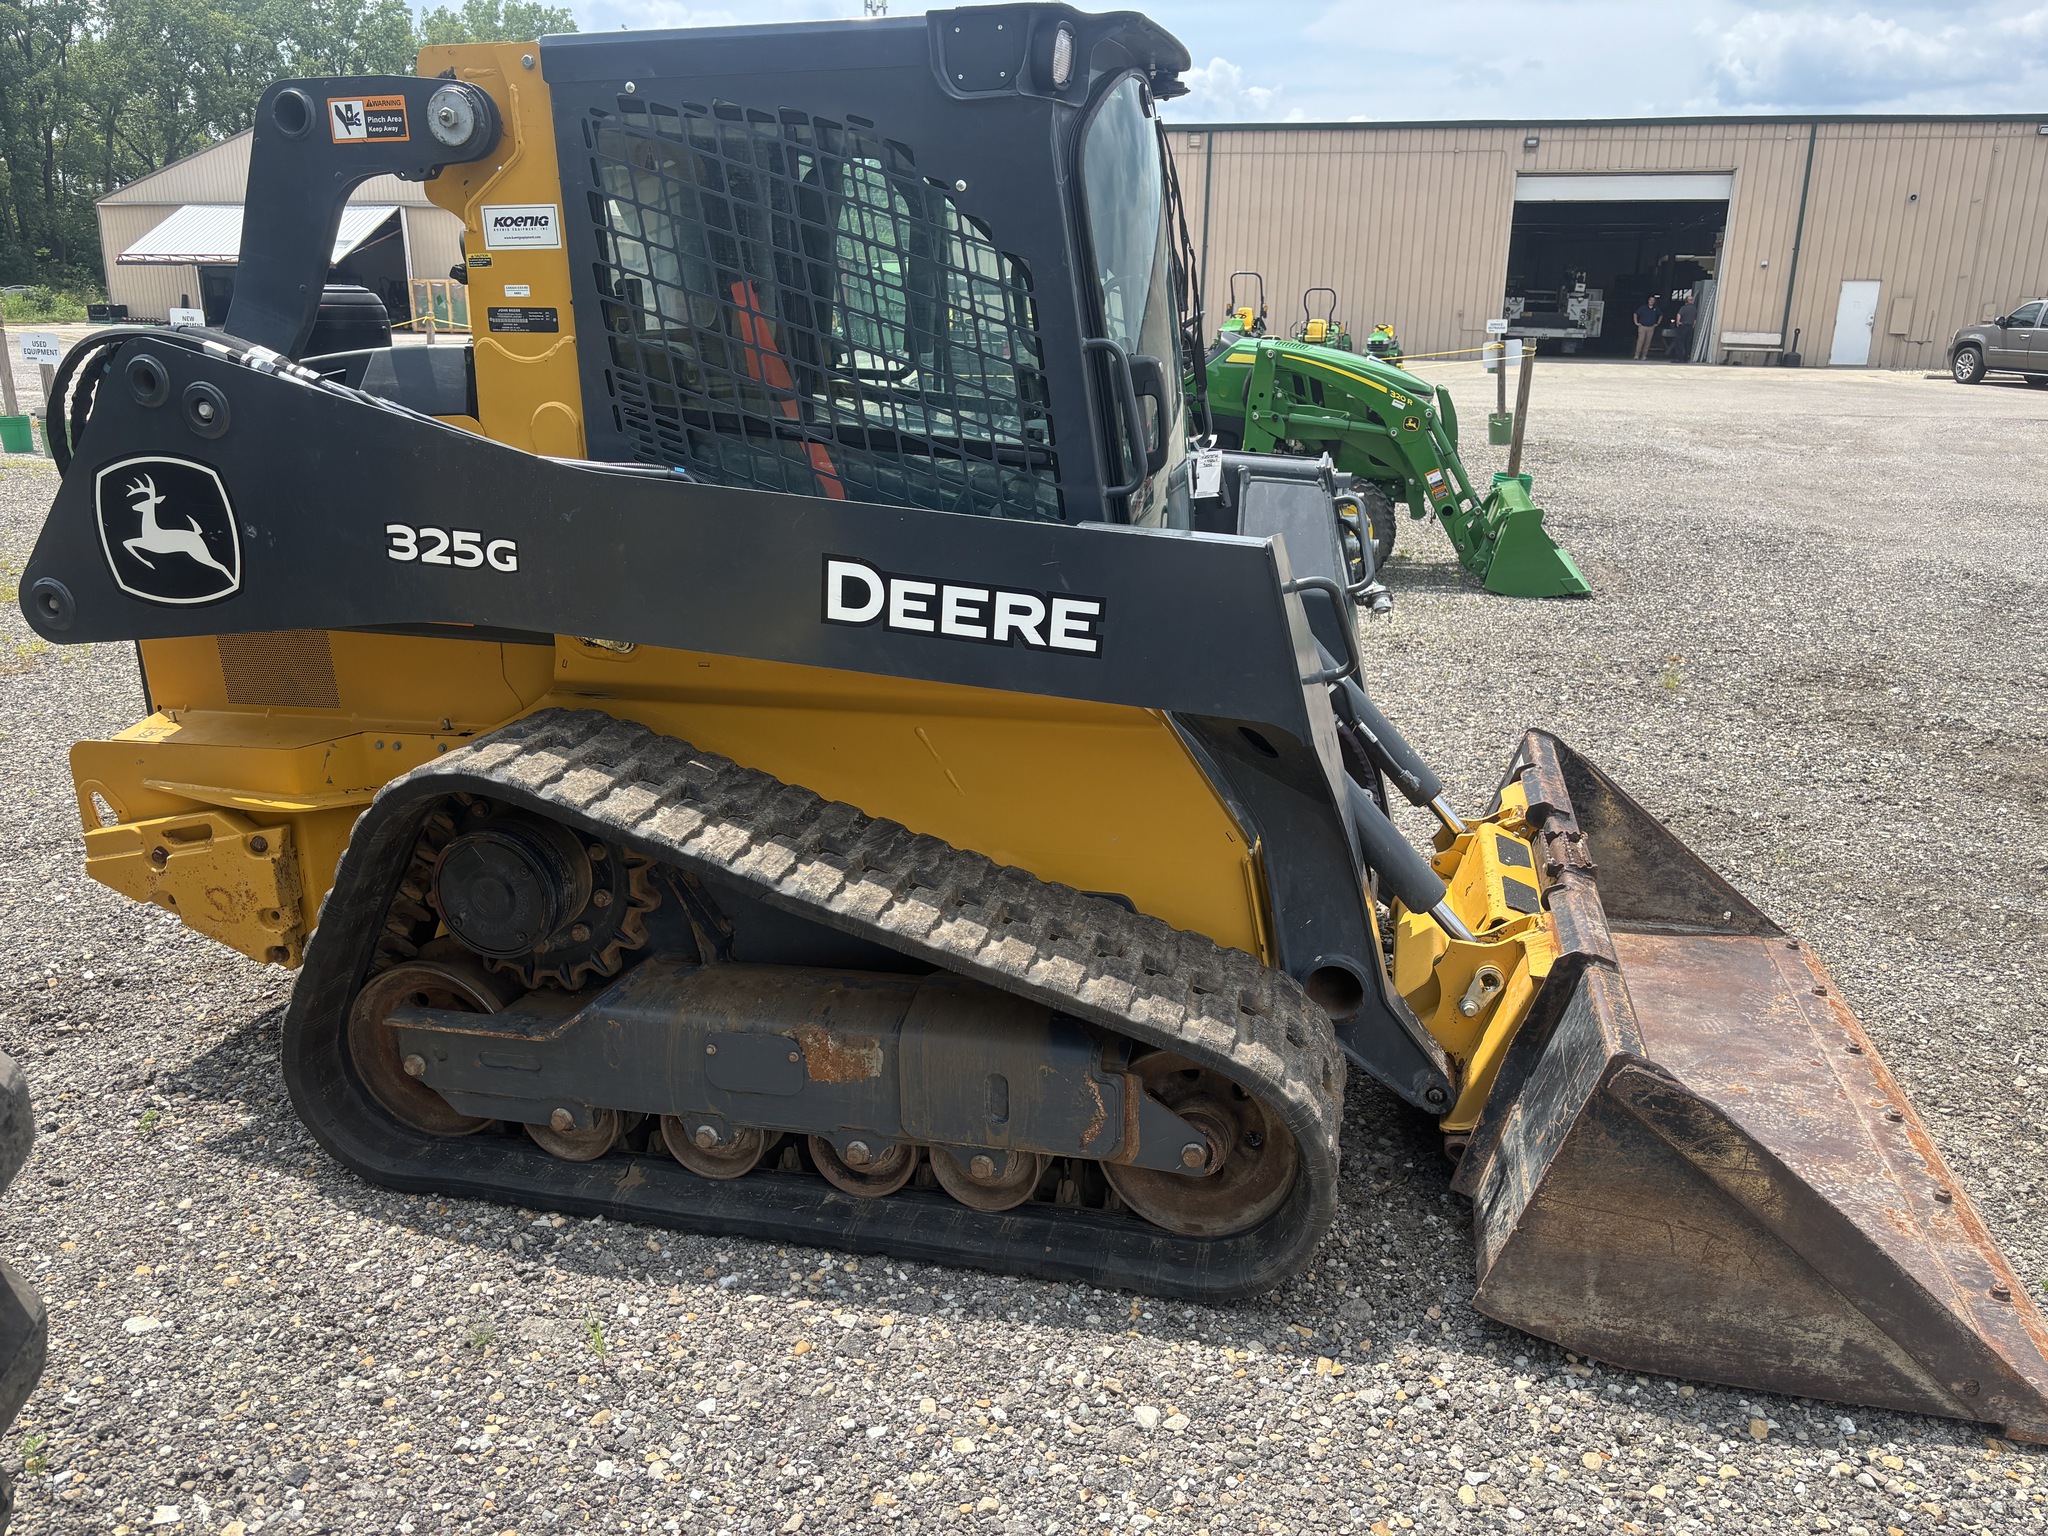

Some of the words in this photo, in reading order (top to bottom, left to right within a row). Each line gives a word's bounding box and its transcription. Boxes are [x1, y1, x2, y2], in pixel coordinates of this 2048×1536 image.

[372, 99, 402, 107] WARNING
[23, 348, 57, 356] EQUIPMENT
[1390, 390, 1406, 402] 320
[386, 524, 518, 572] 325G
[827, 560, 1100, 652] DEERE
